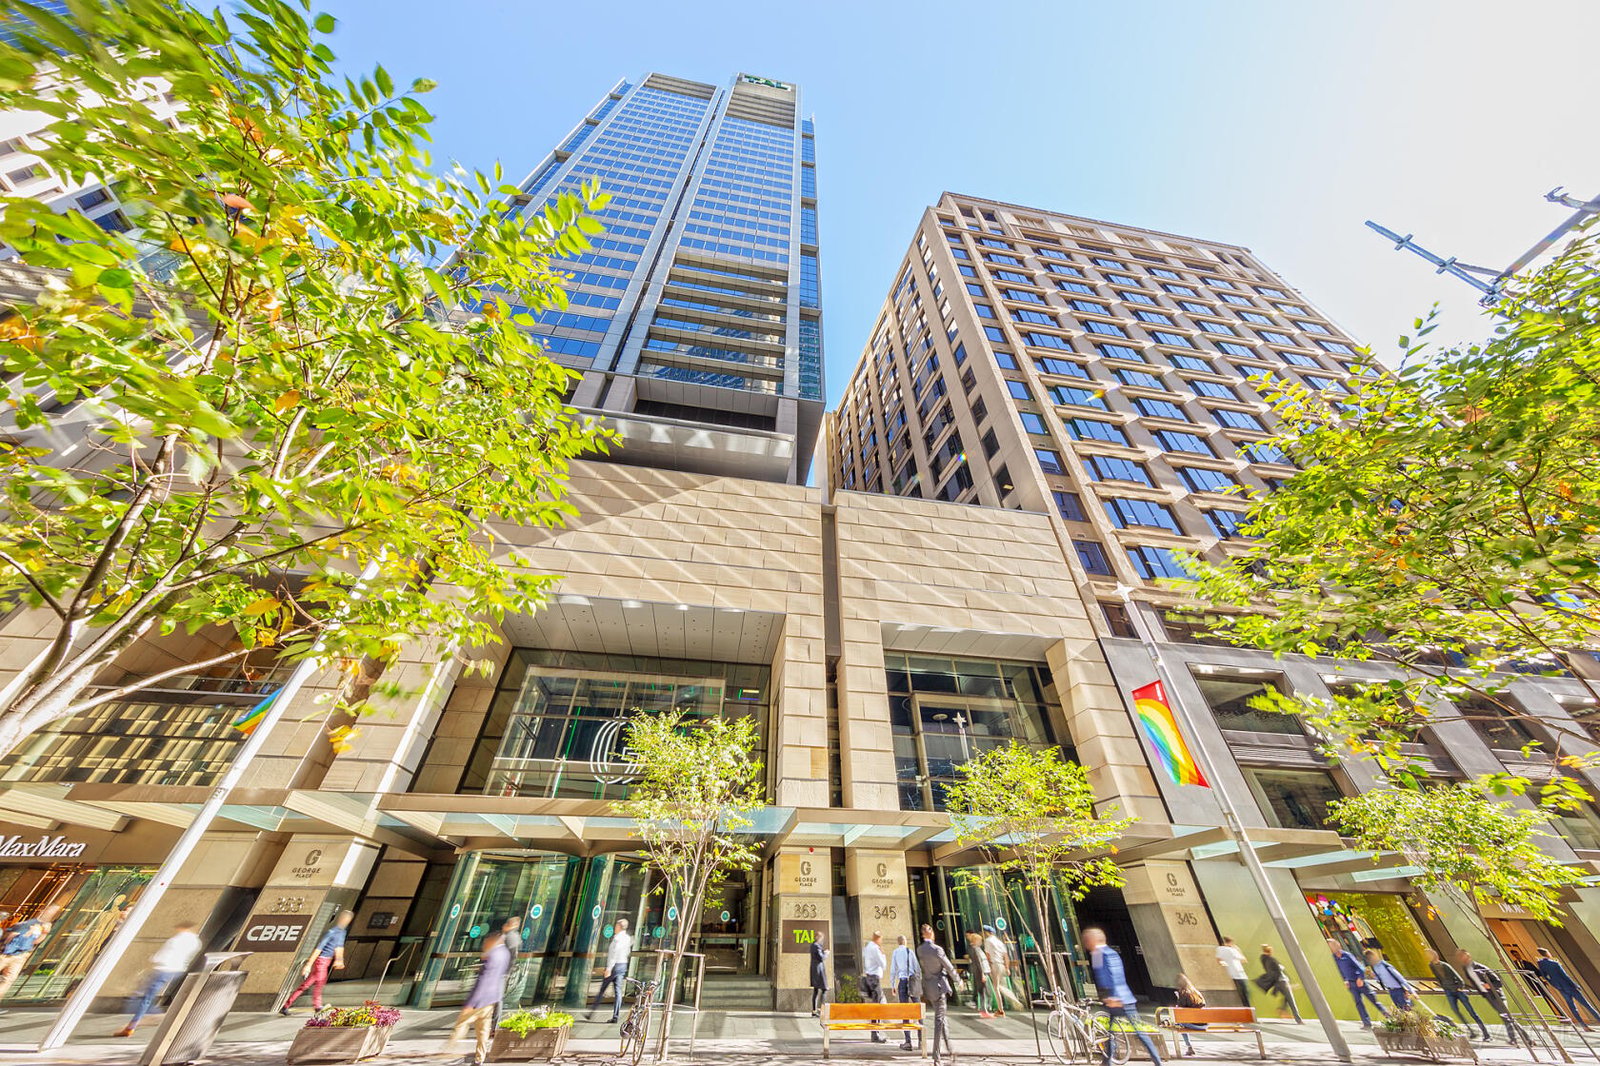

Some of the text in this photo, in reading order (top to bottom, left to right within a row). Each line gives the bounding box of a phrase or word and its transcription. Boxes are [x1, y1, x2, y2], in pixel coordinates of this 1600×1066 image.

[305, 849, 322, 866] G
[800, 861, 811, 876] G
[876, 863, 887, 877] G
[1166, 872, 1178, 886] G
[793, 903, 817, 919] 363
[874, 905, 897, 920] 345
[1175, 911, 1198, 926] 345
[246, 925, 303, 942] CBRE
